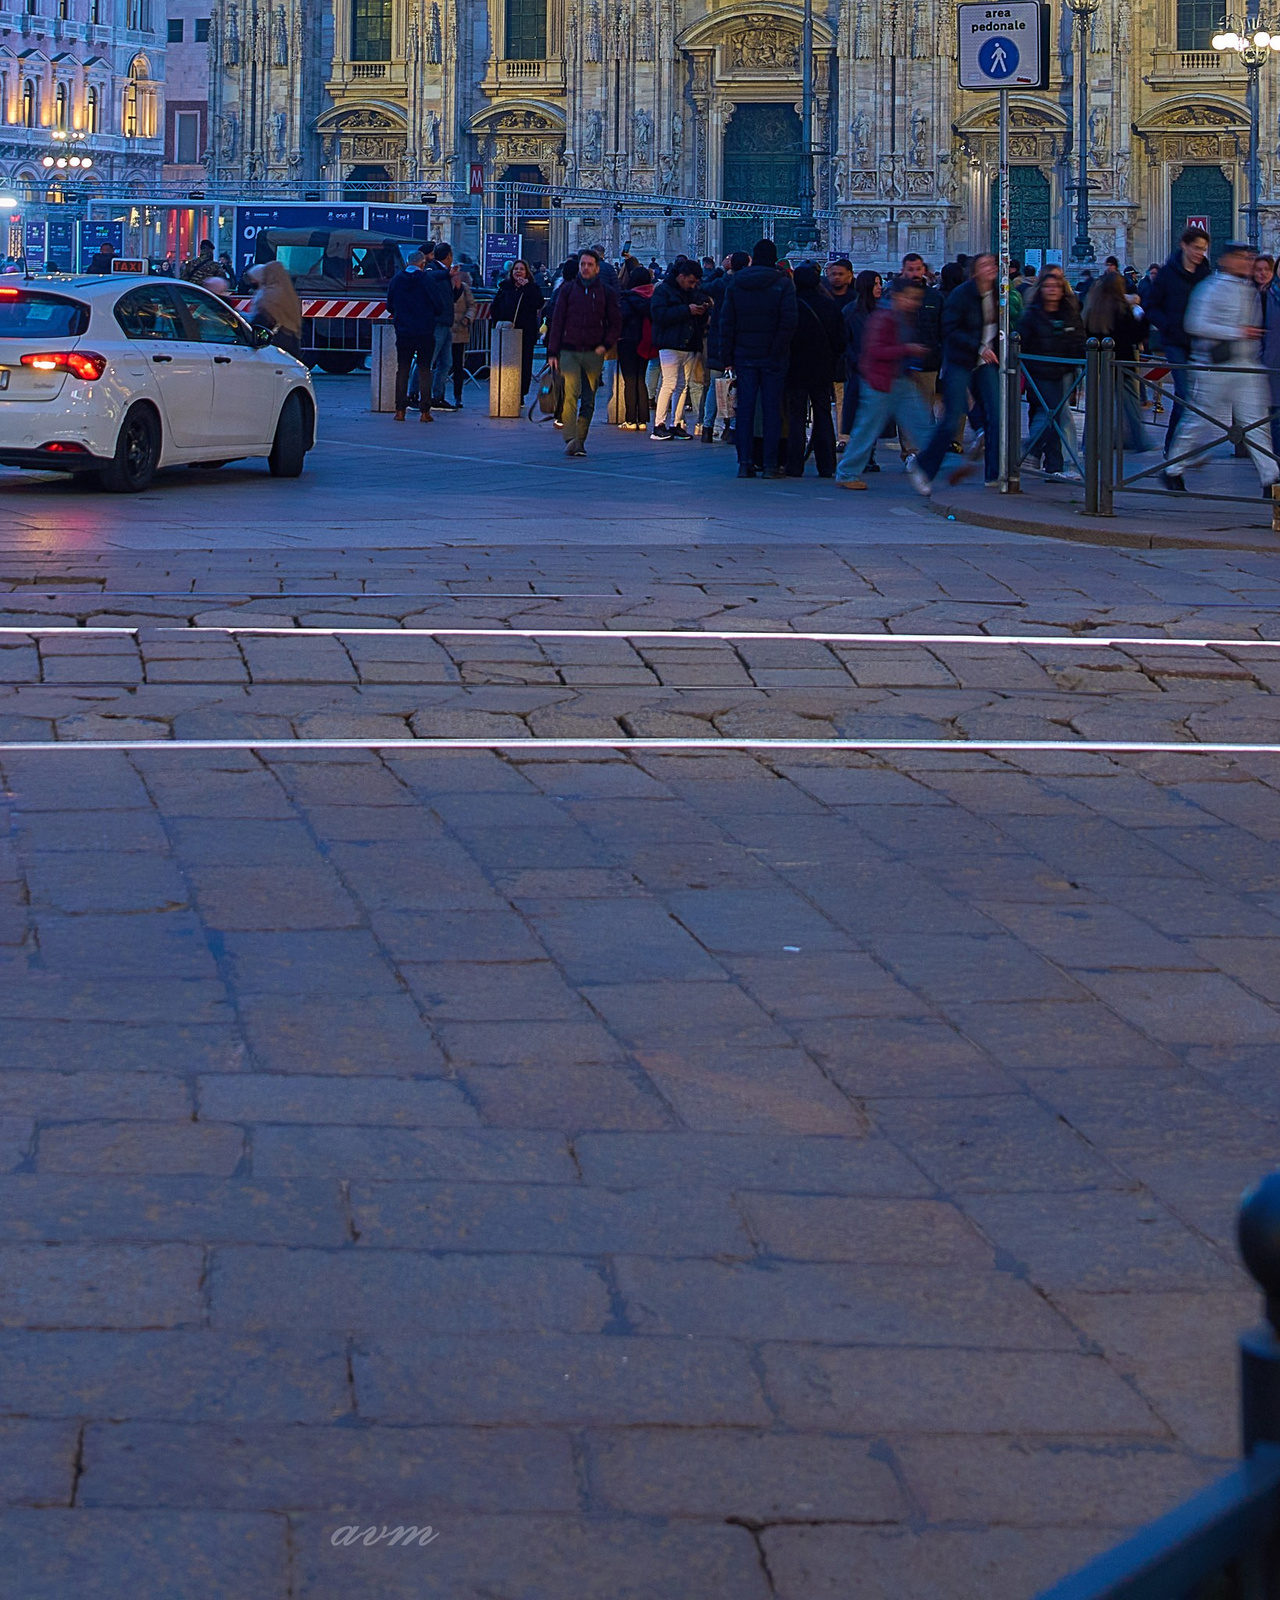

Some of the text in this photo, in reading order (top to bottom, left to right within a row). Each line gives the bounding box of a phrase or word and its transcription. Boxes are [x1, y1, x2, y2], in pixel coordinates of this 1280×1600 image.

[985, 9, 1011, 18] area
[971, 20, 1026, 34] pedonale
[471, 169, 483, 188] M
[114, 261, 142, 272] TAXI
